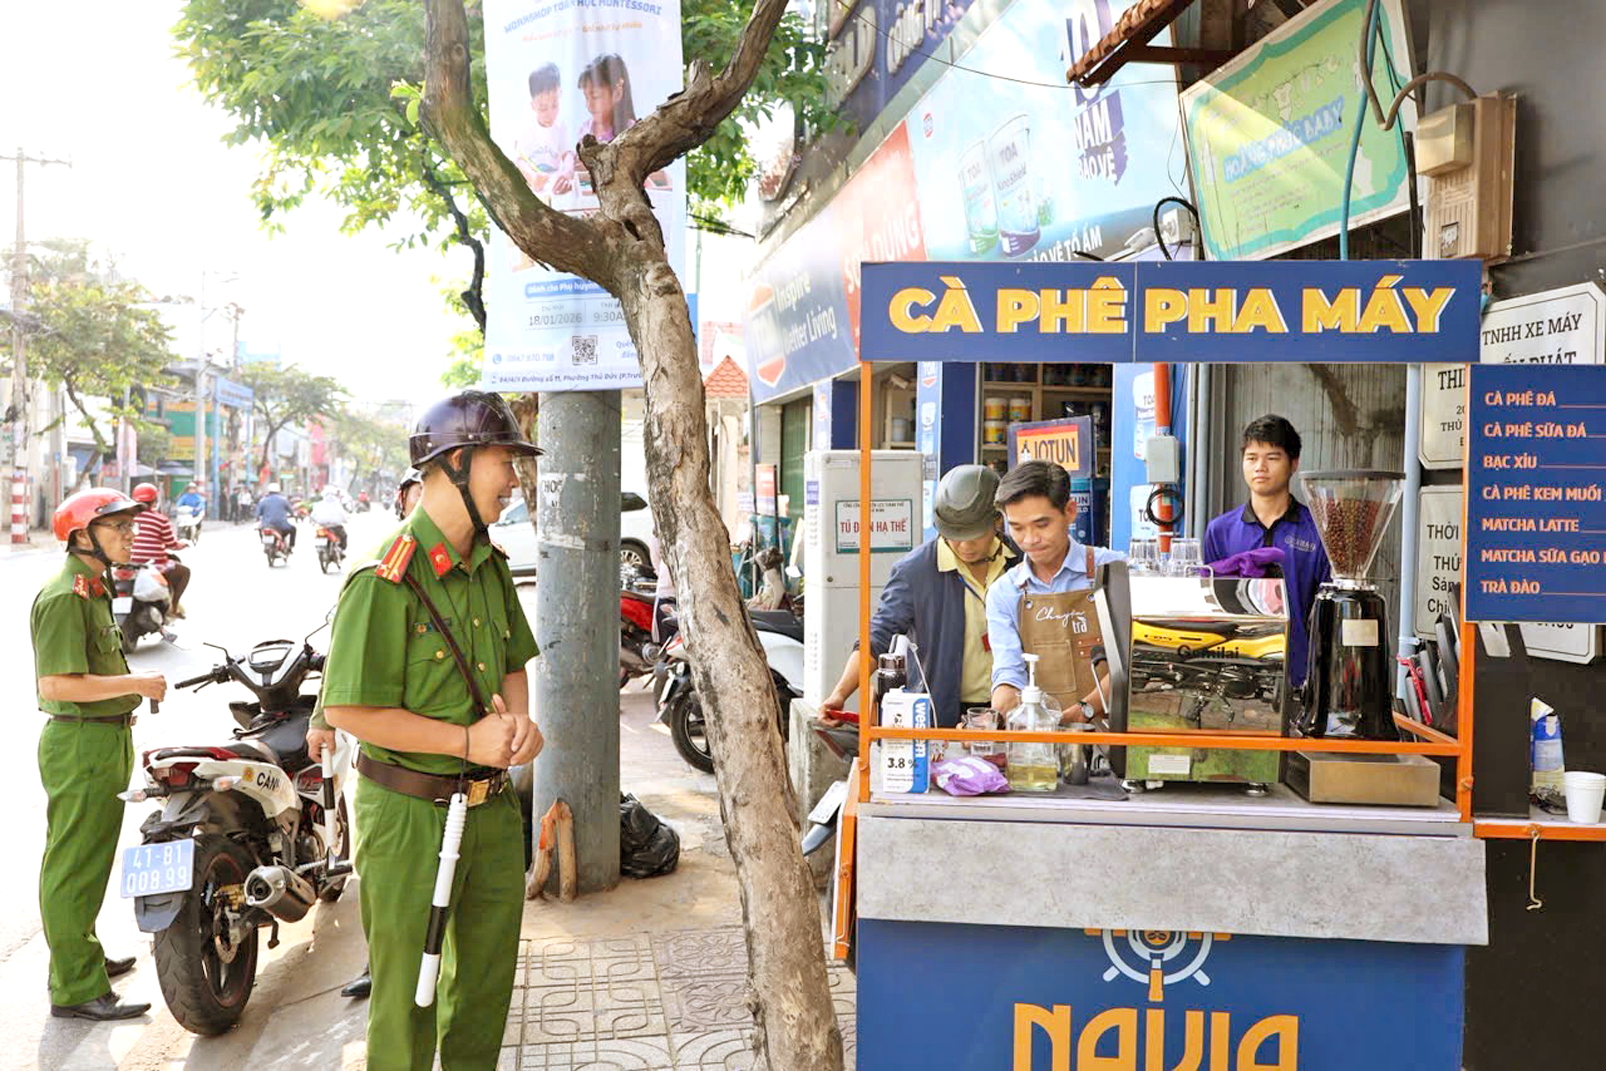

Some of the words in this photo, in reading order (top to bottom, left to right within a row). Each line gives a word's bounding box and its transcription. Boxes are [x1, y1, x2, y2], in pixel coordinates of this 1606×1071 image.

[888, 276, 984, 333] CÀ
[996, 276, 1128, 333] PHÊ
[1144, 287, 1289, 333] PHA
[1302, 274, 1456, 333] MÁY
[529, 312, 583, 326] 18/01/2026
[806, 304, 837, 340] Living
[1482, 325, 1521, 345] TNHH
[1525, 321, 1544, 338] XE
[1548, 312, 1582, 335] MÁY
[1485, 391, 1502, 406] CÀ
[1506, 390, 1533, 406] PHÊ
[1536, 390, 1556, 406] ĐÁ
[1484, 421, 1502, 437] CÀ
[1505, 421, 1532, 437] PHÊ
[1536, 422, 1563, 438] SỮA
[1566, 421, 1587, 437] ĐÁ
[1483, 455, 1510, 471] BẠC
[1482, 484, 1500, 500] CÀ
[1504, 484, 1531, 500] PHÊ
[1534, 487, 1562, 500] KEM
[1566, 484, 1601, 500] MUỐI
[840, 519, 851, 533] TỦ
[853, 521, 874, 533] ĐN
[876, 521, 888, 534] HẠ
[890, 517, 908, 532] THẾ
[1481, 518, 1536, 532] MATCHA
[1539, 518, 1579, 532] LATTE
[1481, 549, 1536, 563] MATCHA
[1539, 548, 1567, 563] SỮA
[1570, 550, 1600, 566] GẠO
[1480, 578, 1507, 594] TRÀ
[1510, 578, 1540, 594] ĐÀO
[887, 757, 905, 769] 3.8
[126, 866, 188, 894] 008.99
